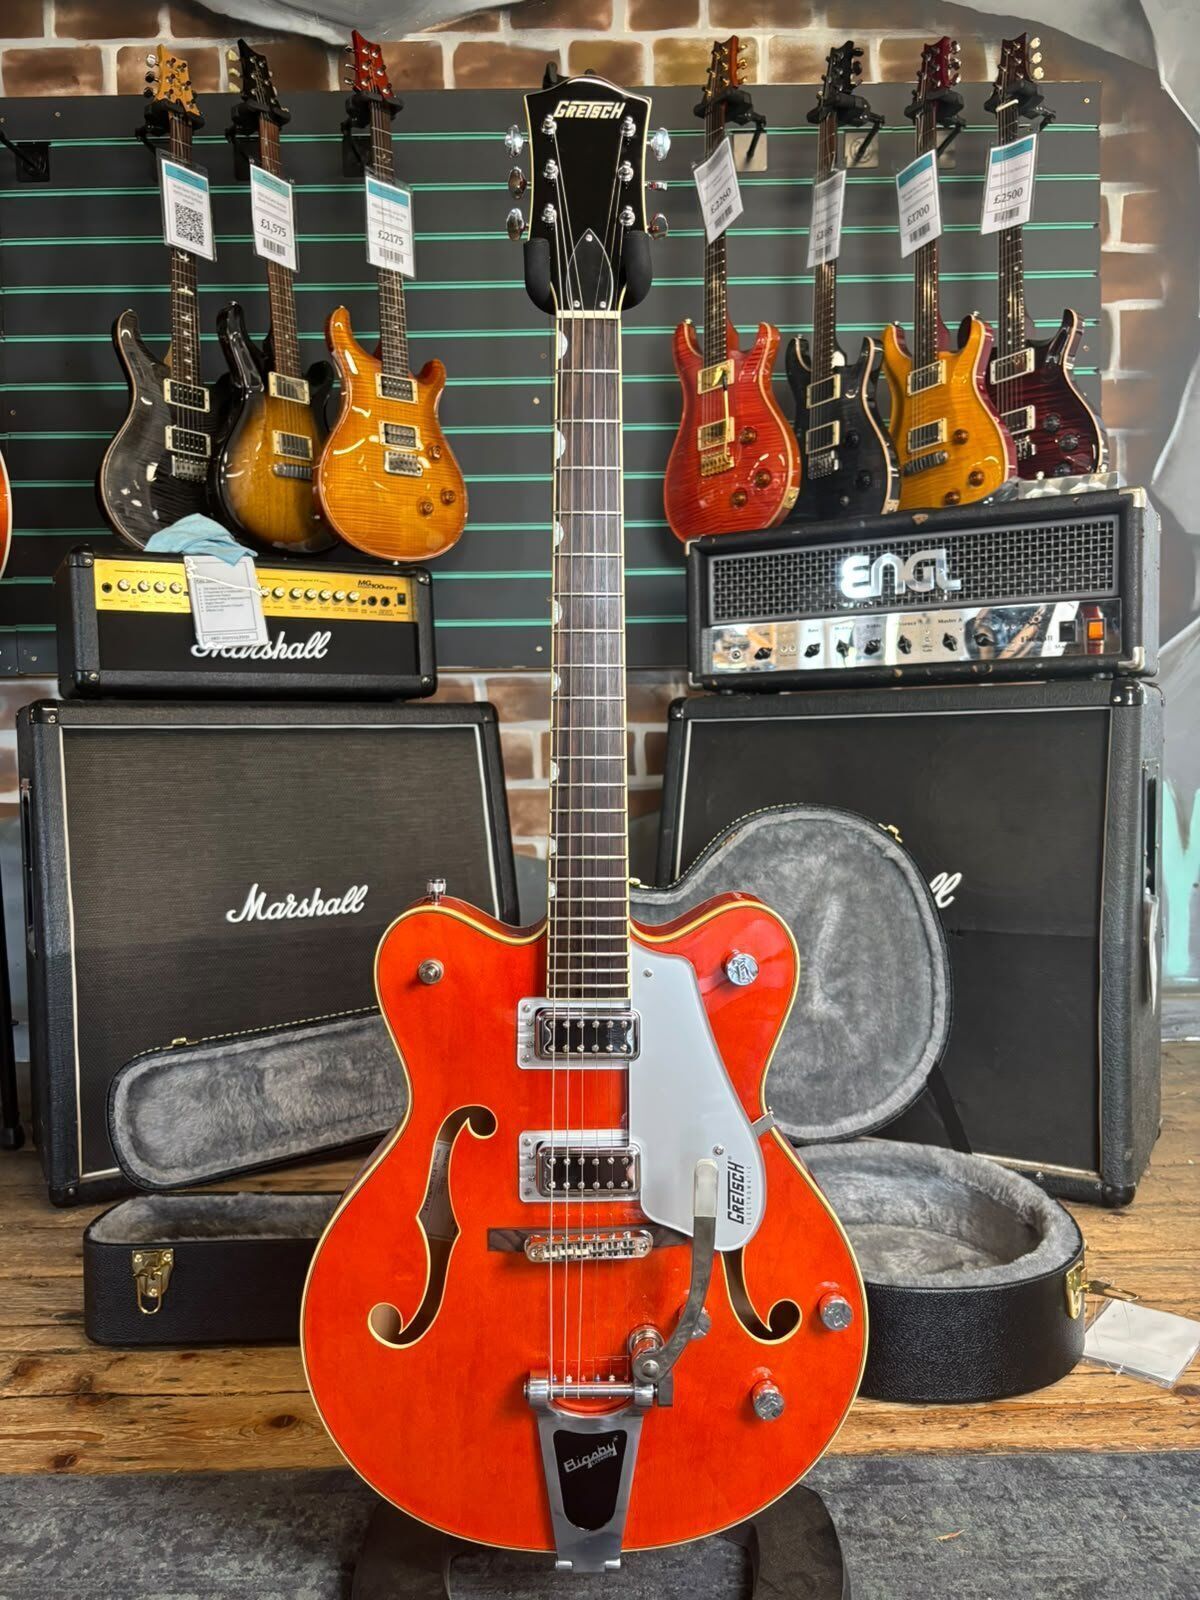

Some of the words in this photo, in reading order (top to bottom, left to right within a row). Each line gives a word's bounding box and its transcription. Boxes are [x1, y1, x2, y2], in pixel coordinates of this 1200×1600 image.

[553, 100, 627, 119] GRETSCH
[993, 187, 1023, 205] £2500
[260, 218, 287, 237] £1,575
[378, 229, 404, 246] £2175
[839, 548, 961, 599] ENGL
[225, 882, 369, 923] Marshall
[727, 1160, 745, 1225] GRETSCH
[563, 1442, 618, 1473] Bigsby
